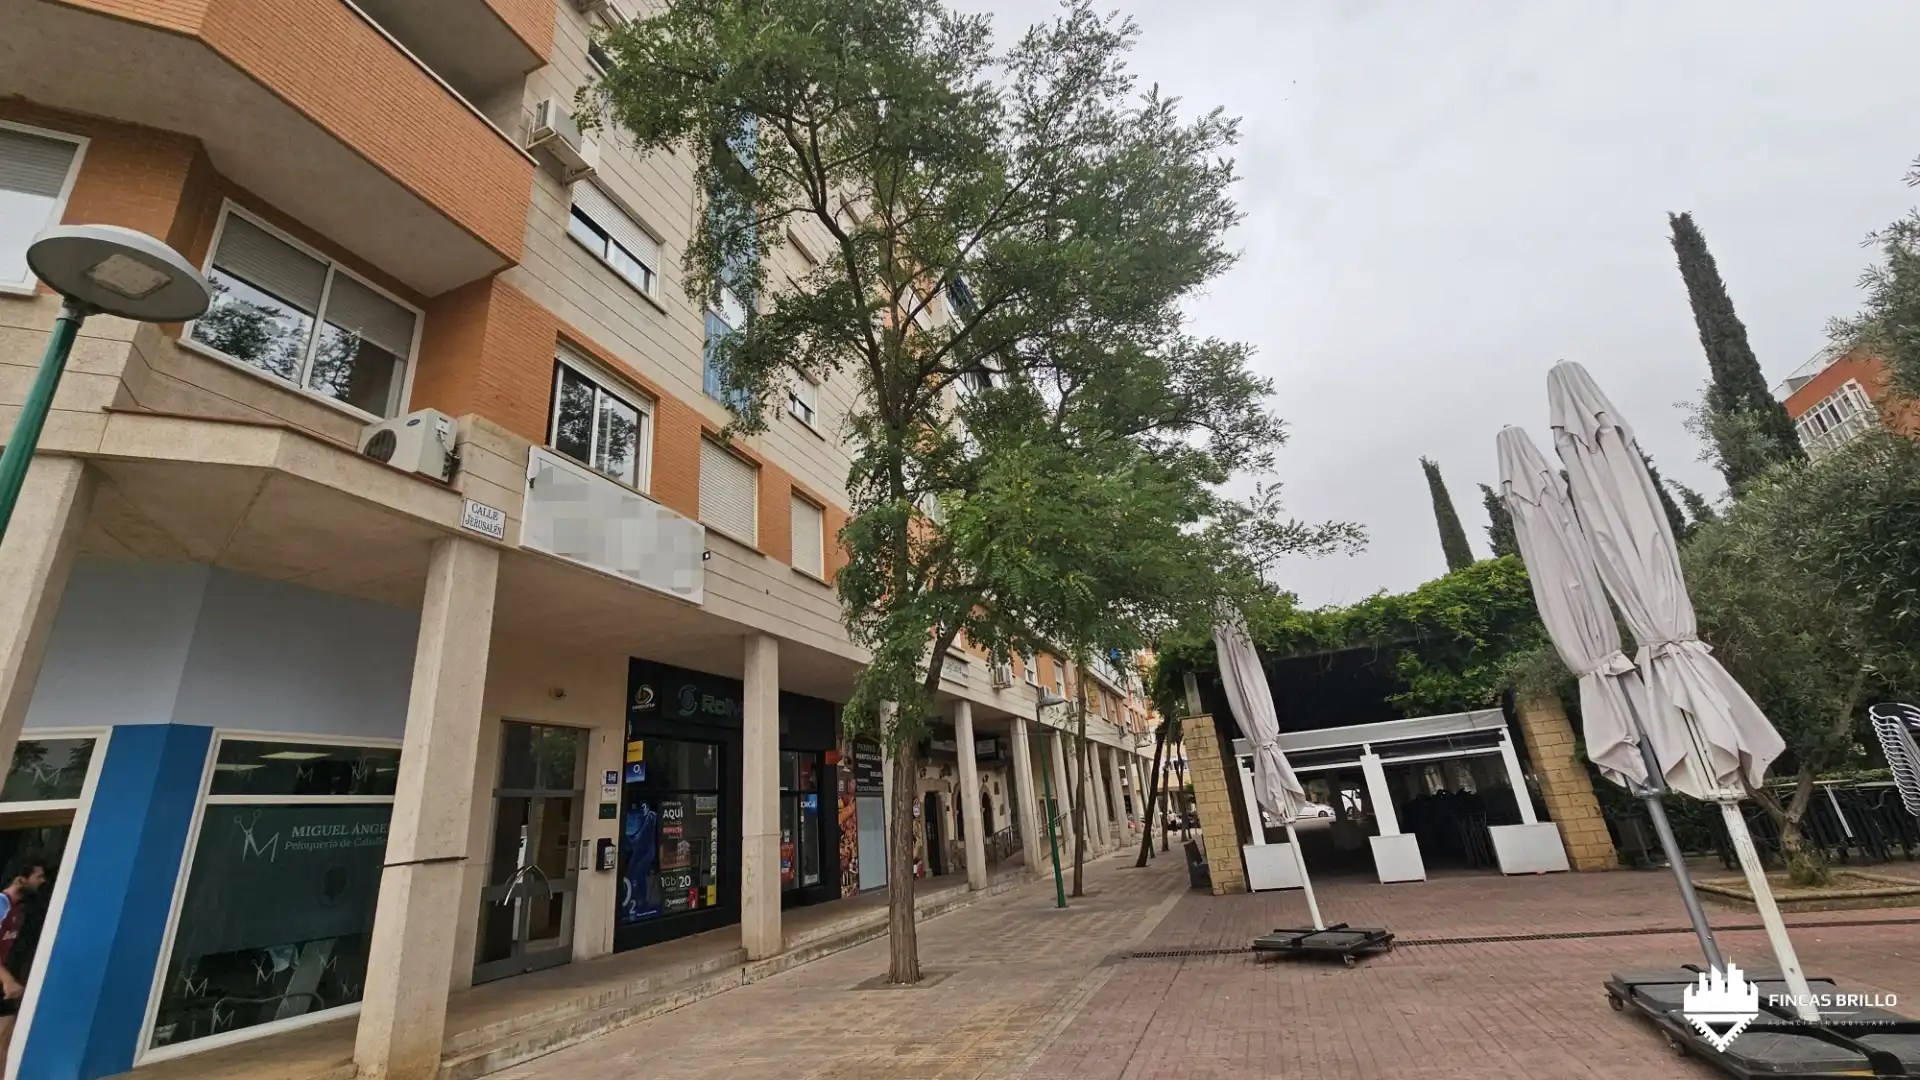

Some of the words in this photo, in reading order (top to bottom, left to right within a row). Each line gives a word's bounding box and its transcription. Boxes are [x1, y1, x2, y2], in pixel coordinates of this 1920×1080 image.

[472, 503, 499, 520] CALLE
[465, 515, 502, 535] JERUSALÉN
[662, 805, 684, 819] AQUÍ
[291, 825, 349, 838] MIGUEL
[340, 838, 352, 848] de
[678, 875, 691, 888] 20
